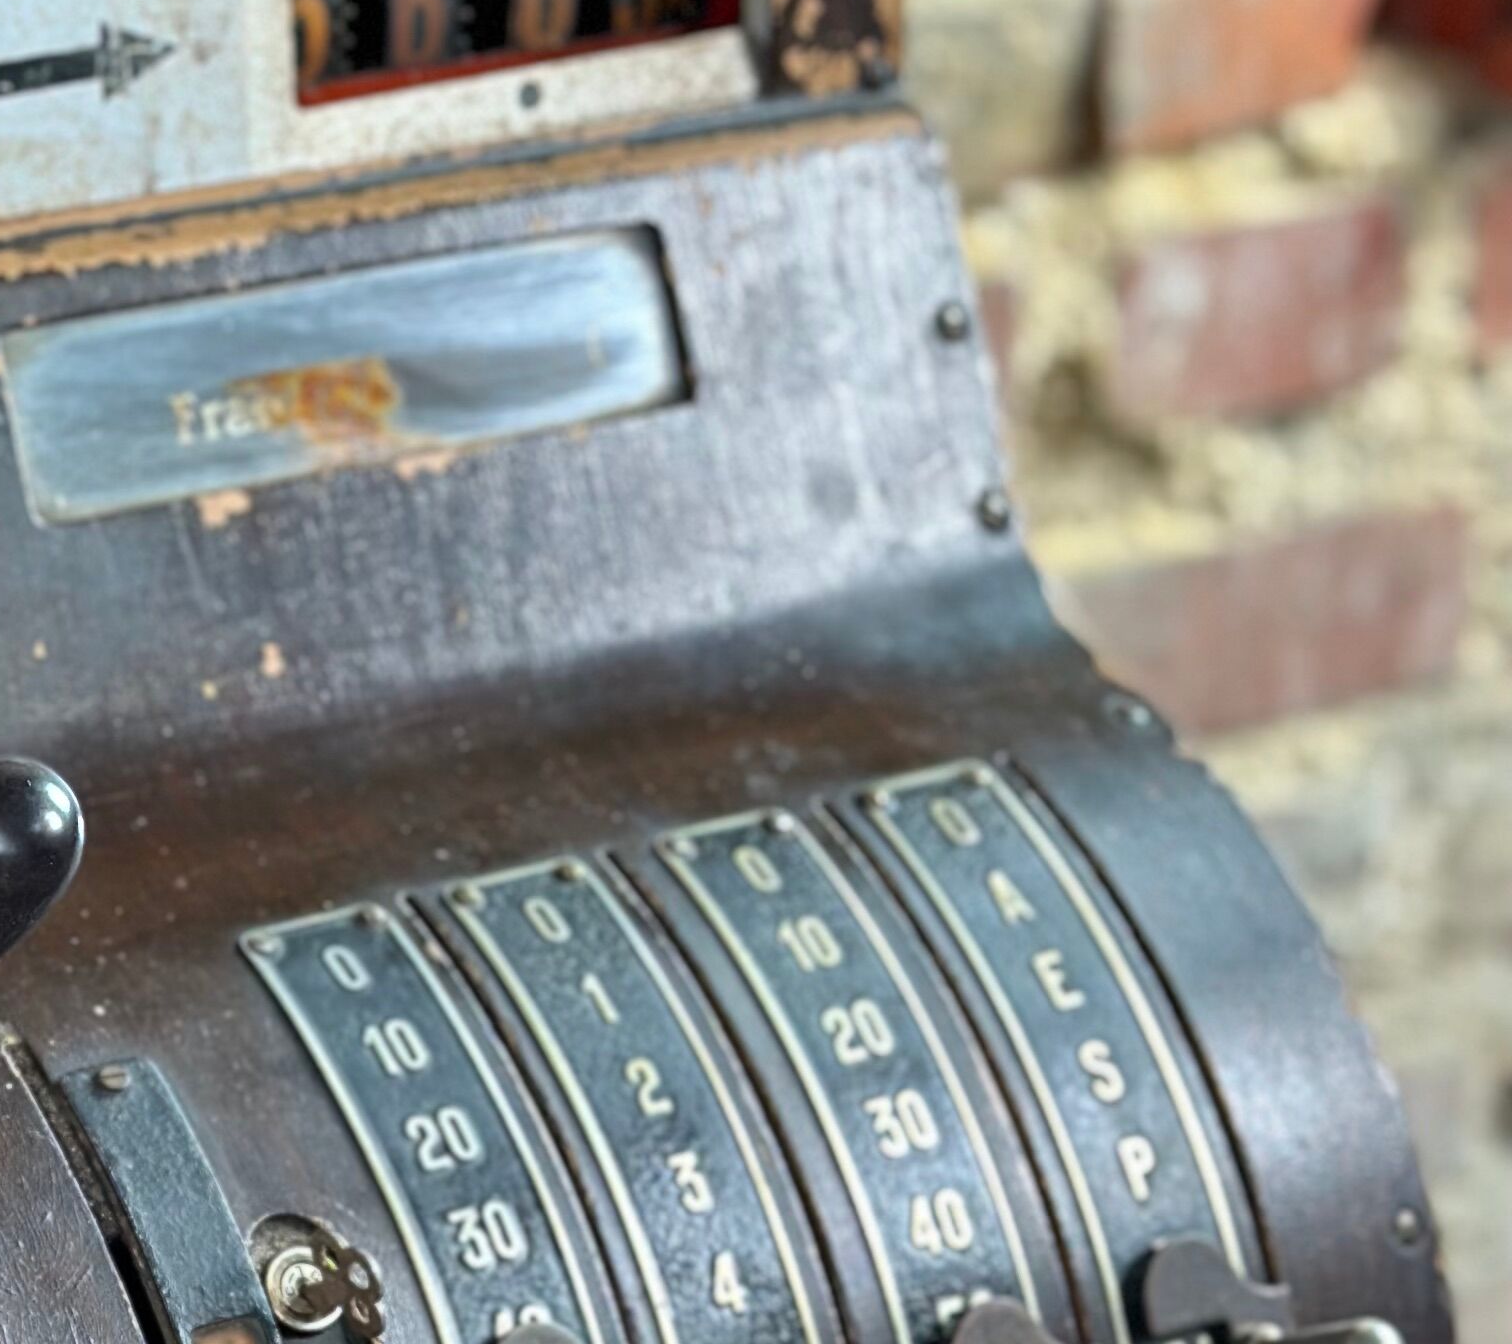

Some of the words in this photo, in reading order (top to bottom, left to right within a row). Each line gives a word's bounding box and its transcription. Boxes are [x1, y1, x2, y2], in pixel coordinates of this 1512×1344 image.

[929, 796, 981, 847] 0
[732, 845, 783, 893] 0
[987, 868, 1036, 927] A
[523, 896, 571, 943] 0
[776, 914, 844, 973] 10
[322, 945, 369, 991] 0
[582, 973, 620, 1023] 1
[1031, 949, 1085, 1011] E
[362, 1018, 430, 1077] 10
[821, 997, 894, 1066] 20
[625, 1057, 674, 1119] 2
[1078, 1038, 1125, 1103] S
[405, 1105, 481, 1172] 20
[863, 1088, 940, 1158] 30
[668, 1151, 714, 1214] 3
[1117, 1135, 1156, 1202] P
[446, 1199, 526, 1270] 30
[908, 1187, 974, 1256] 40
[711, 1250, 747, 1313] 4
